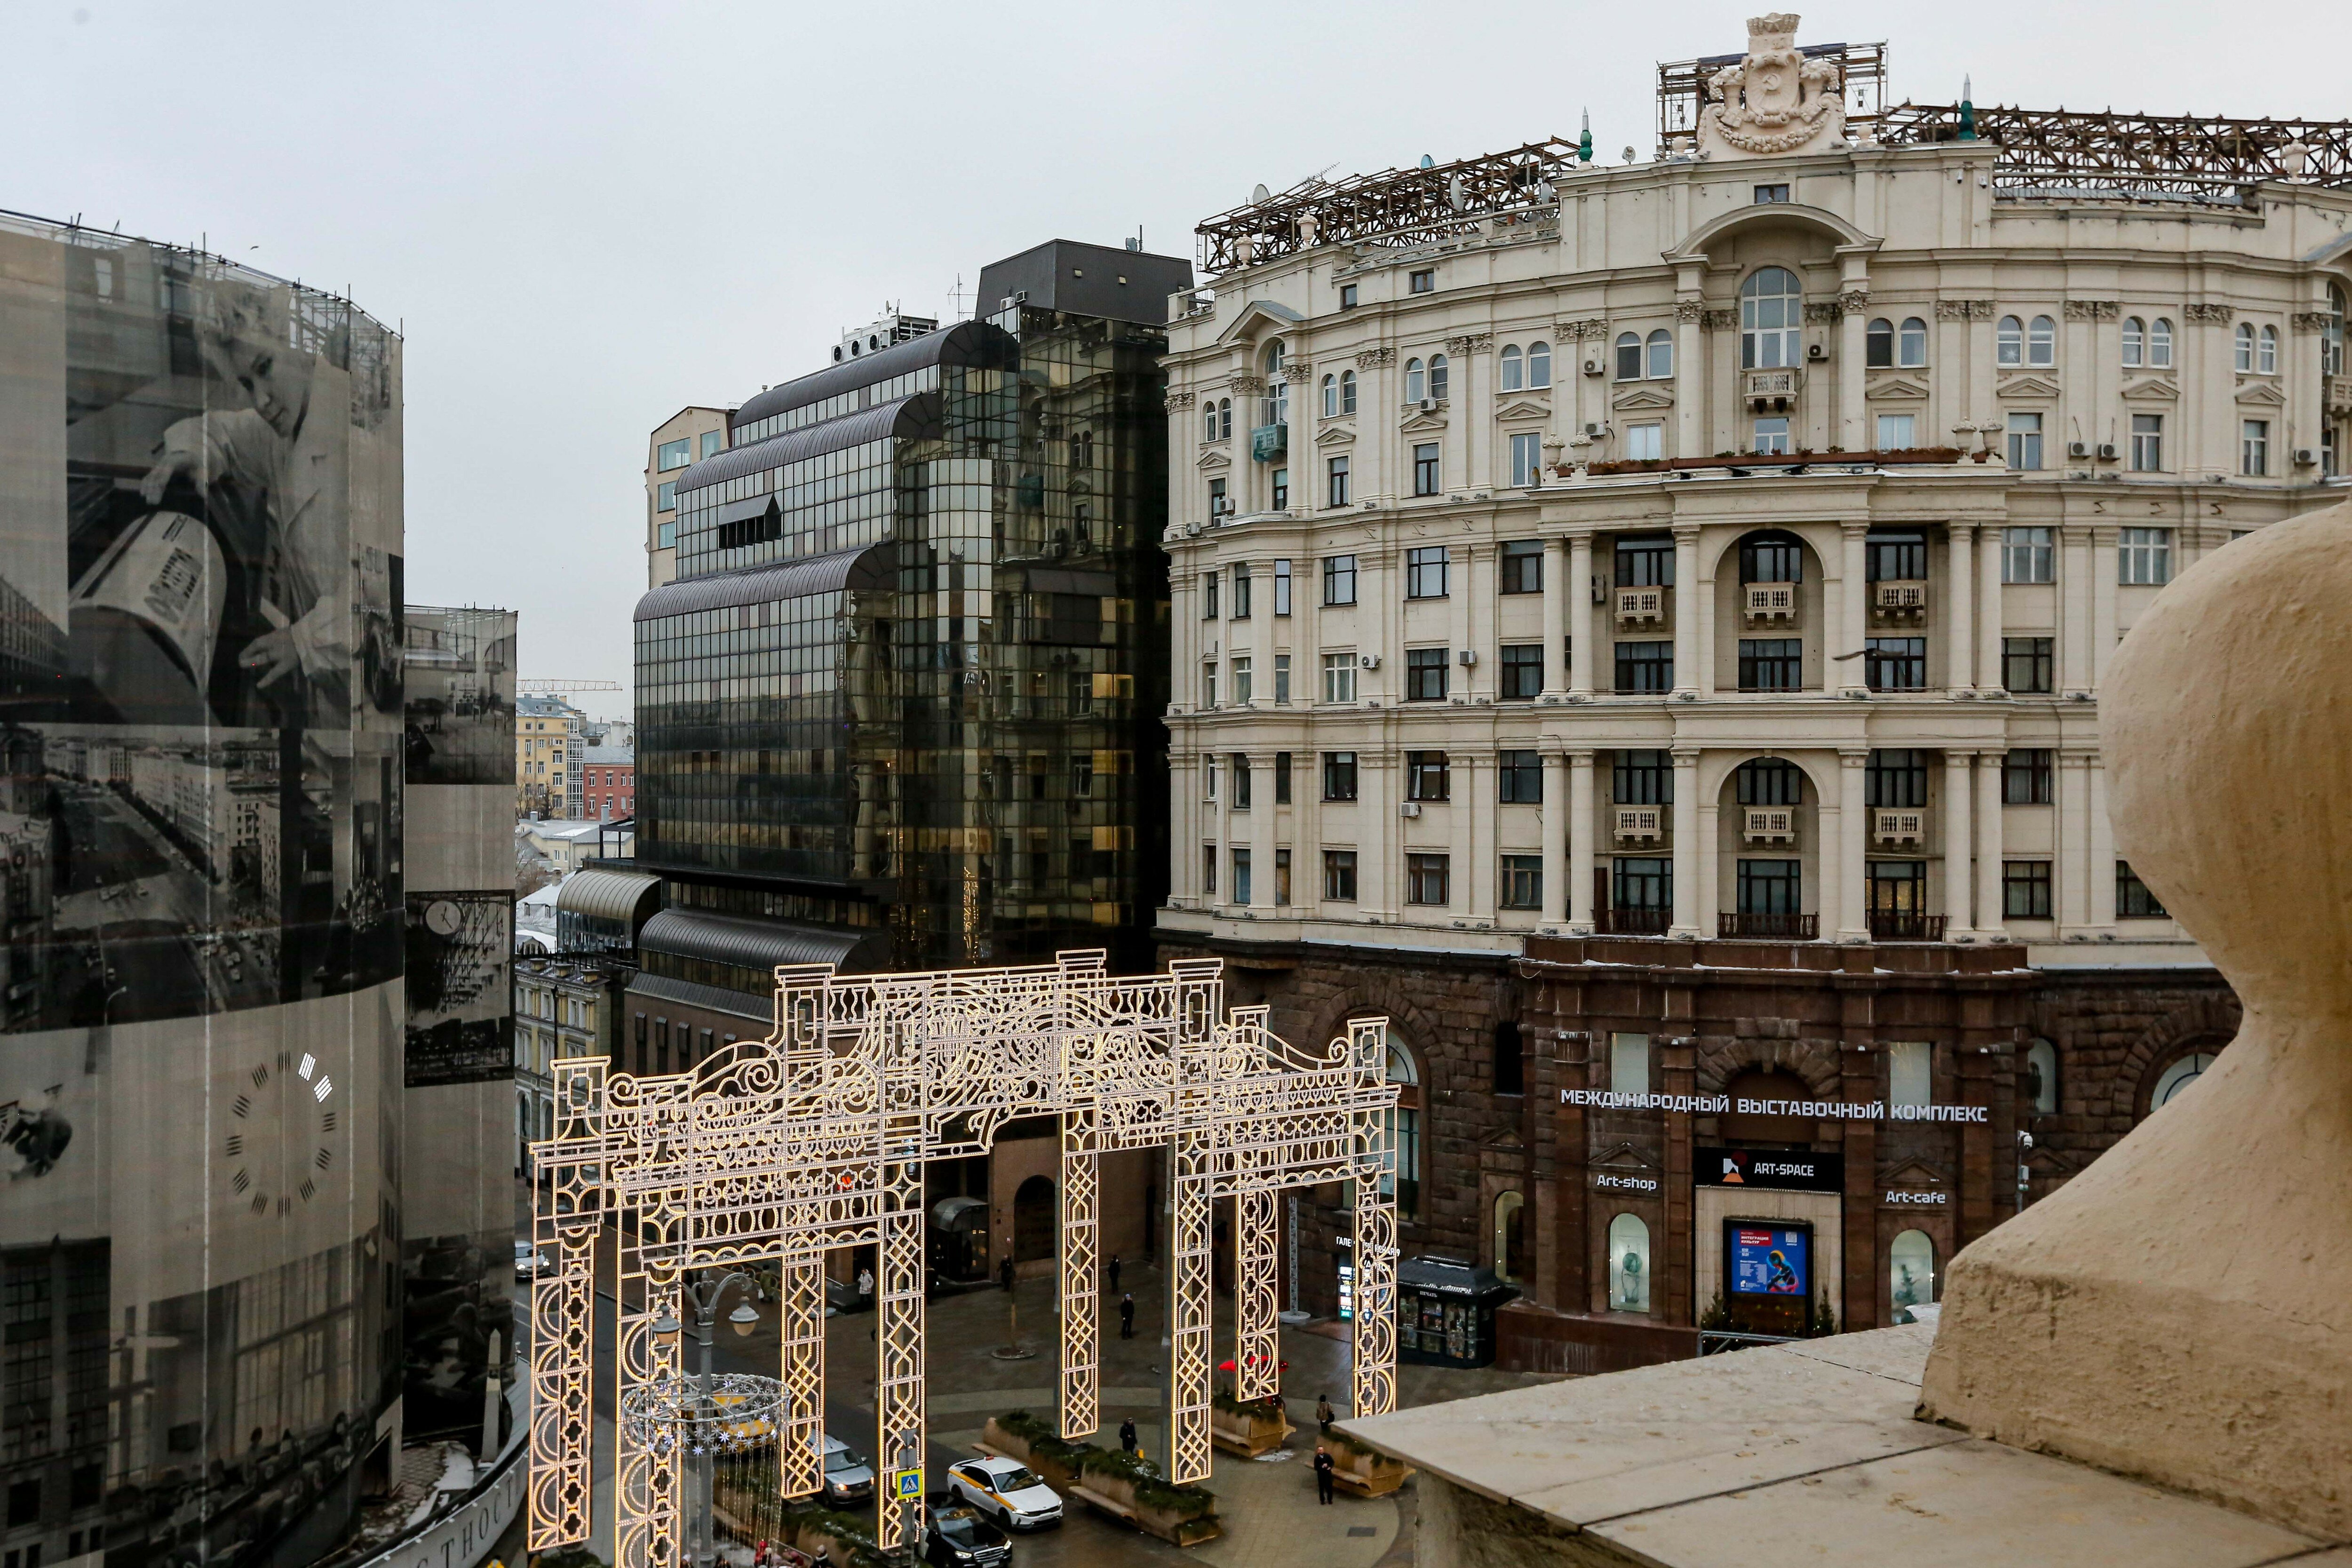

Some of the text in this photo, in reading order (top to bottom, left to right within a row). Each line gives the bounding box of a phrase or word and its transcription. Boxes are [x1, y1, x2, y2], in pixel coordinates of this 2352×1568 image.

[1561, 1089, 1987, 1122] МЕЖДУНАРОДНЫЙ ВЫСТАВОЧНЫЙ КОМПЛЕКС
[1754, 1162, 1815, 1177] ART-SPACE
[1597, 1175, 1657, 1191] Art-shop
[1885, 1190, 1946, 1204] Art-cafe
